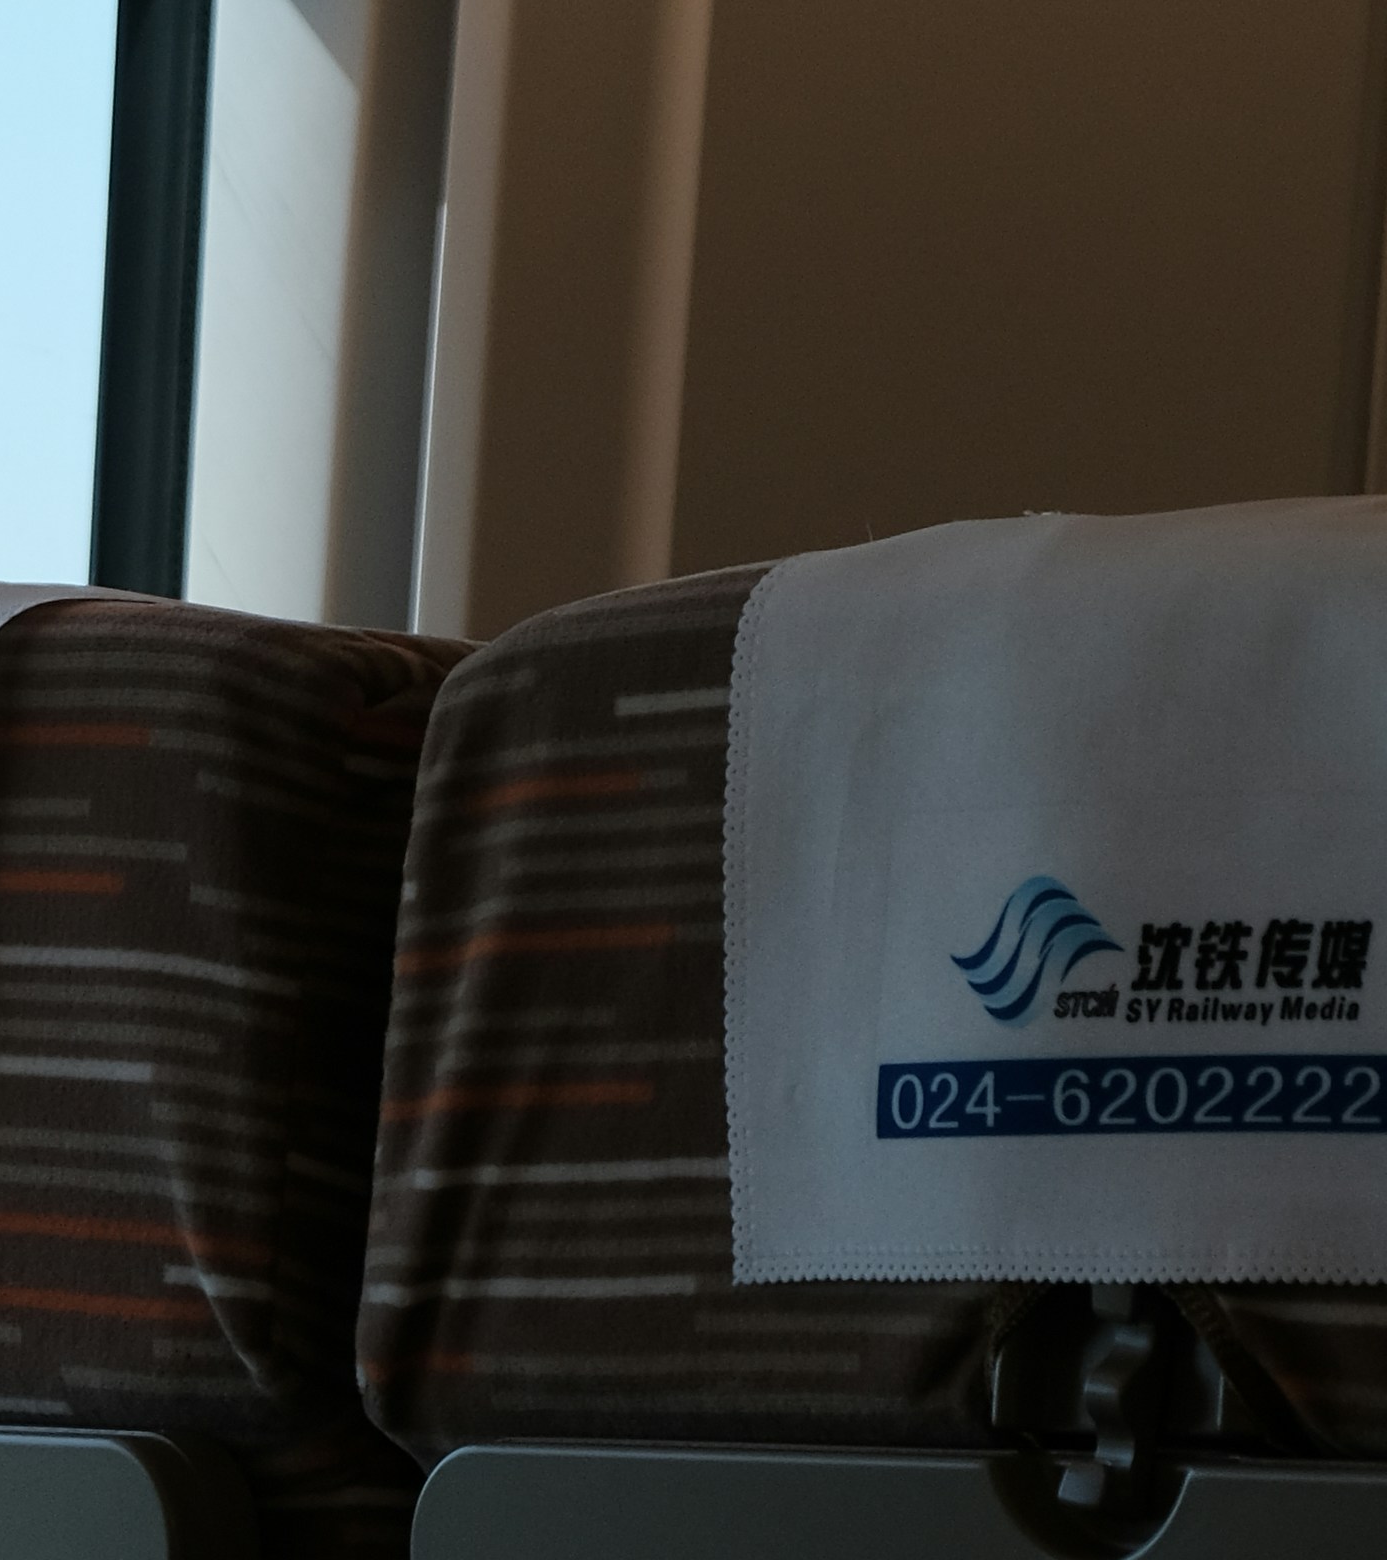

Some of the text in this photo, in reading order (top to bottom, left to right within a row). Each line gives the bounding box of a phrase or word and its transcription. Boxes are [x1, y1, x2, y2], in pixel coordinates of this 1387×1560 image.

[1131, 919, 1374, 991] 沈铁传媒
[1126, 995, 1361, 1026] SY Railway Media
